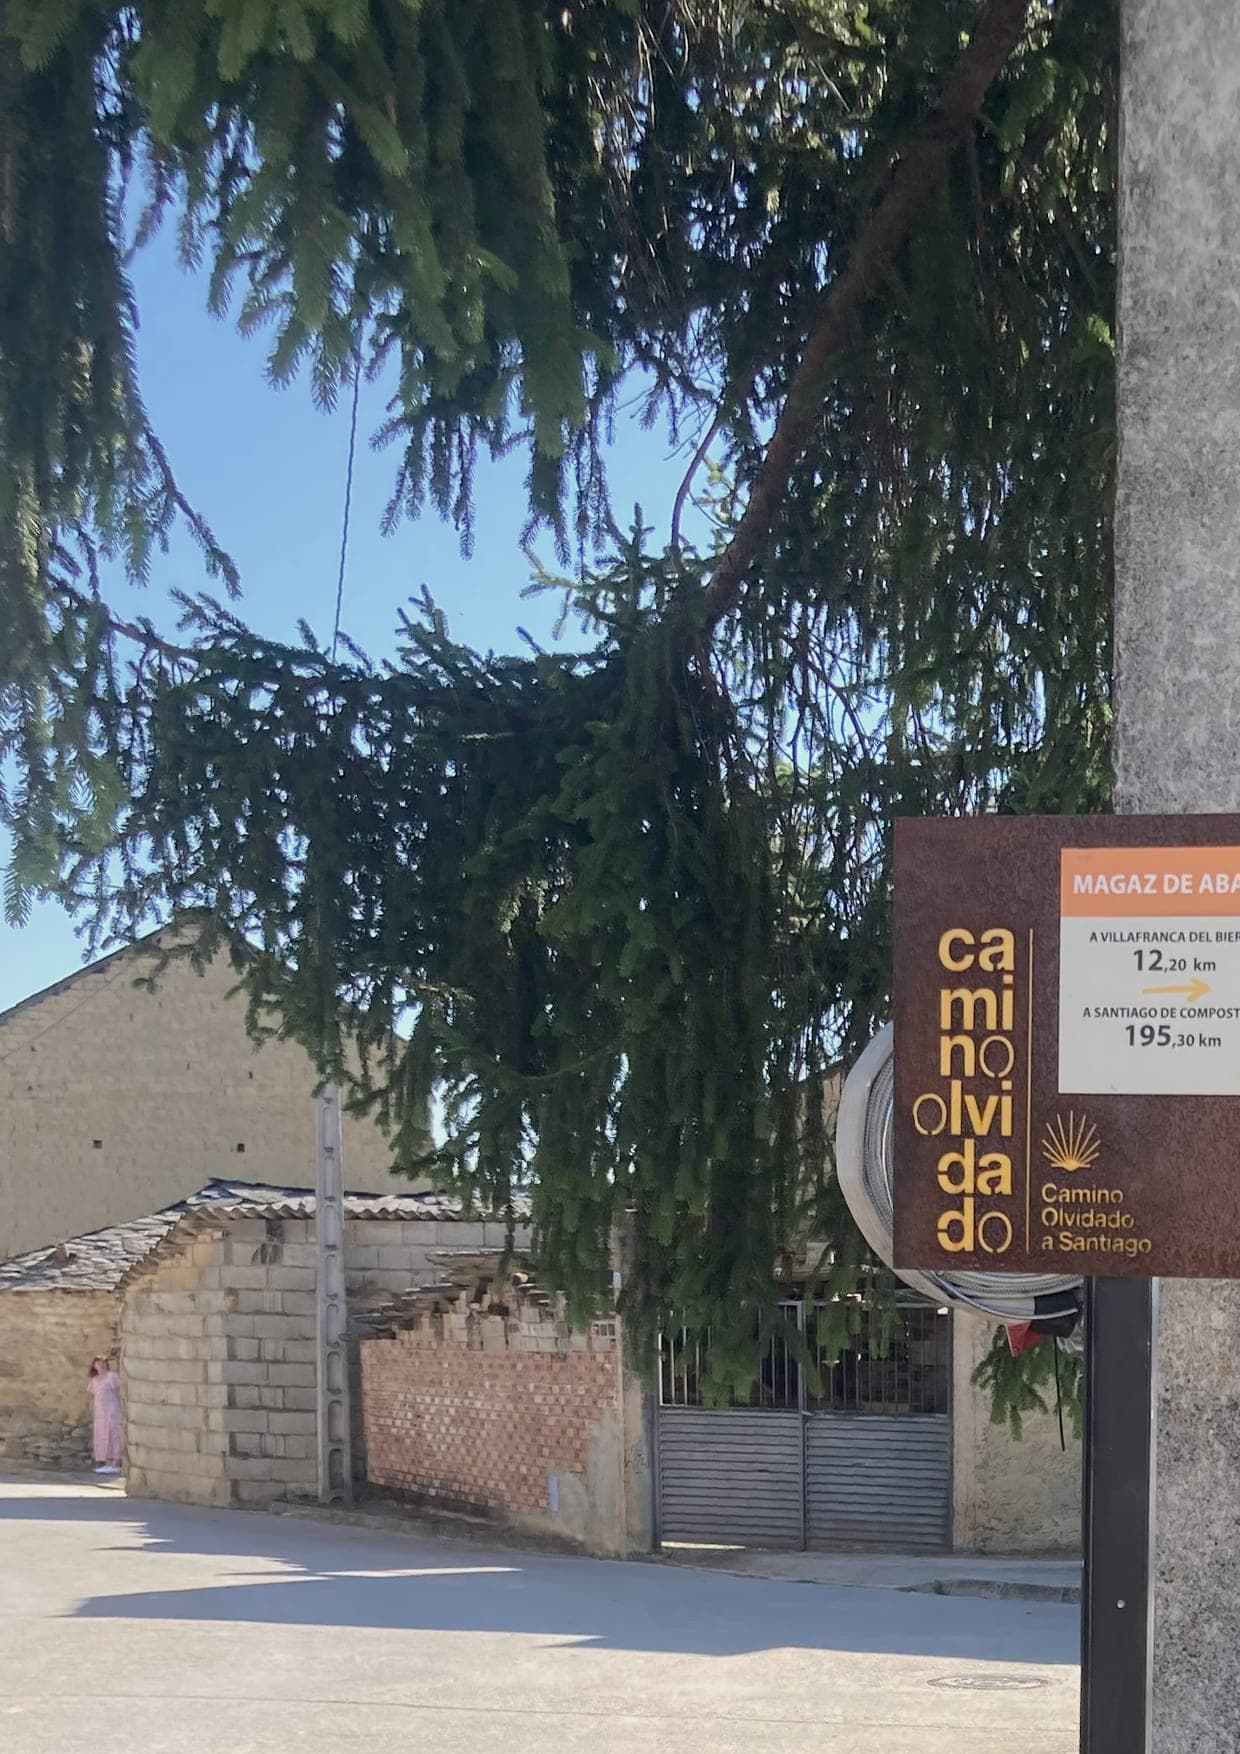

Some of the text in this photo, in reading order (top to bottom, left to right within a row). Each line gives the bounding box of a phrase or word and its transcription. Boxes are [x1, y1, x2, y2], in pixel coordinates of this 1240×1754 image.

[1073, 873, 1158, 895] MAGAZ
[1163, 873, 1193, 894] DE
[1089, 931, 1098, 943] A
[1101, 931, 1186, 943] VILLAFRANCA
[1189, 931, 1212, 943] DEL
[938, 928, 1015, 972] ca
[1133, 949, 1216, 973] 12,20 km
[940, 974, 1014, 1031] mi
[1083, 1007, 1091, 1018] A
[1094, 1007, 1157, 1019] SANTIAGO
[1160, 1007, 1177, 1019] DE
[1125, 1024, 1222, 1049] 195,30 km
[937, 1138, 1012, 1195] da
[1041, 1182, 1124, 1204] Camino
[1041, 1207, 1135, 1229] Olvidado
[1041, 1231, 1152, 1258] a Santiago
